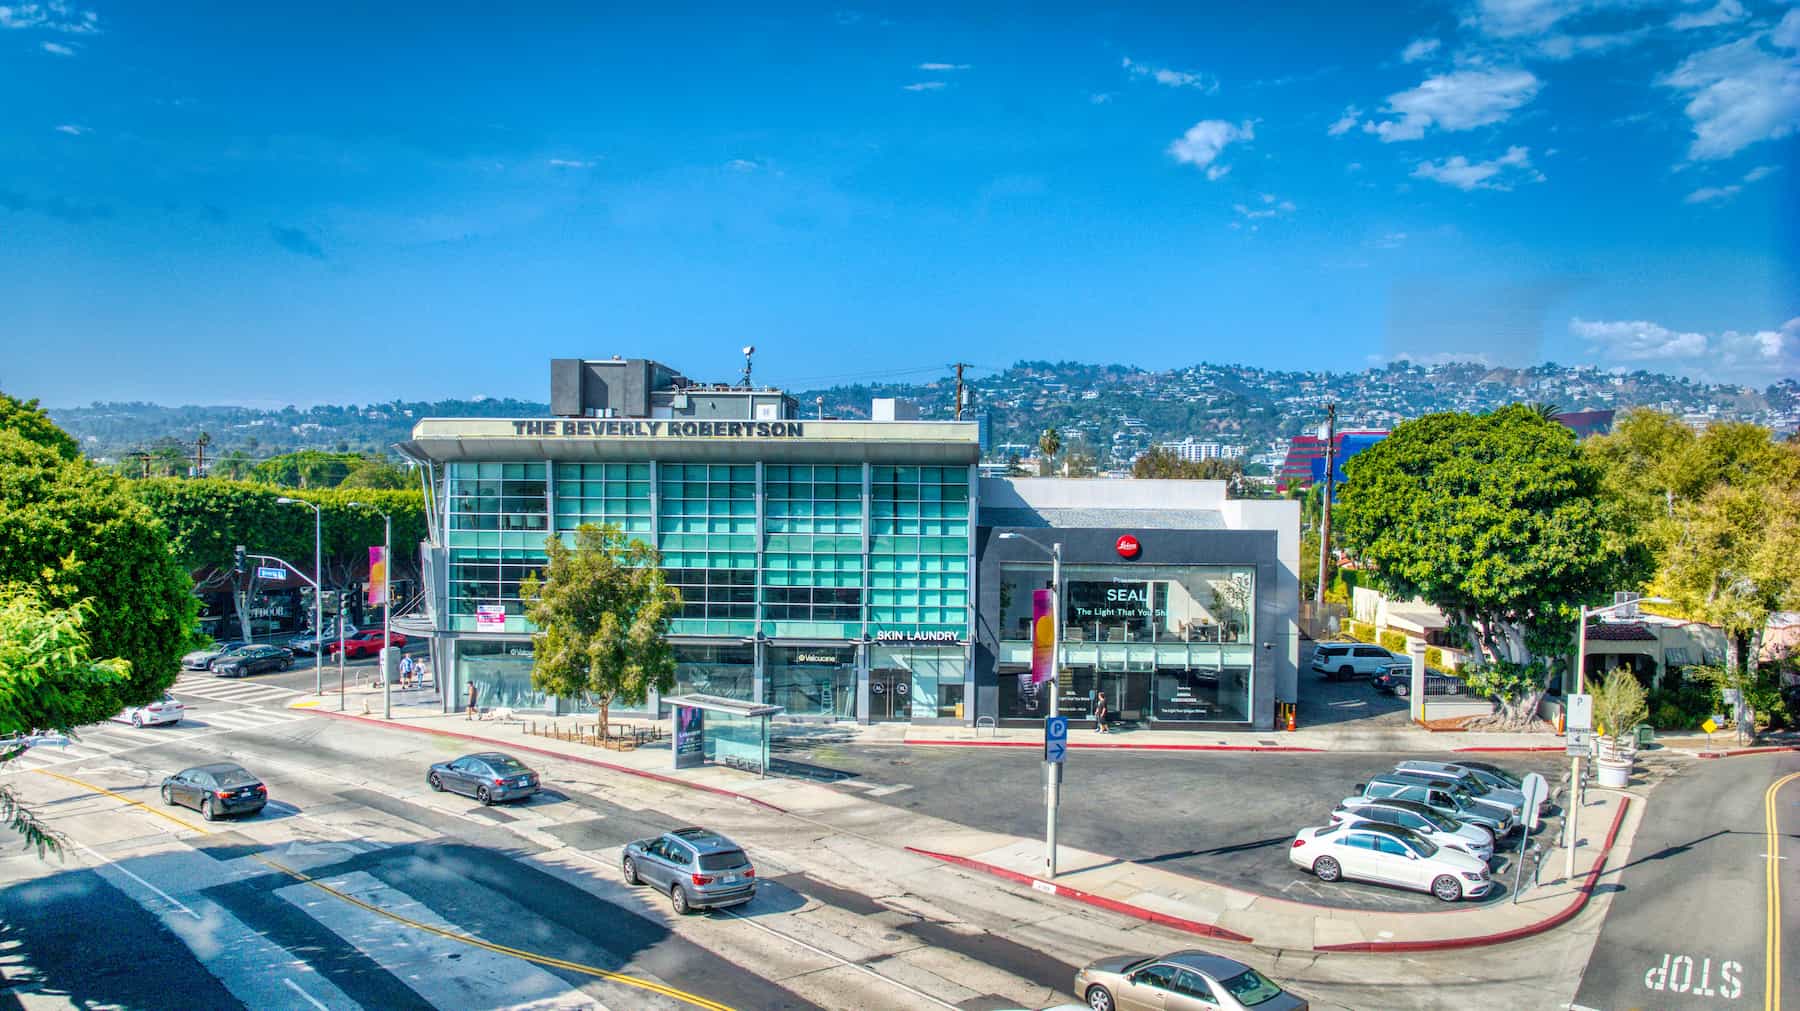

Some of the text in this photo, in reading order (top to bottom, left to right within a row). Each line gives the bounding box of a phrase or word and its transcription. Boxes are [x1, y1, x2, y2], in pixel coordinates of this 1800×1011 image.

[512, 421, 803, 437] THE BEVERLY ROBERTSON
[1107, 588, 1148, 602] SEAL
[1076, 607, 1092, 616] The
[1094, 607, 1115, 617] Light
[1117, 607, 1135, 616] That
[877, 630, 959, 641] SKIN LAUNDRY
[1645, 953, 1743, 999] STOP
